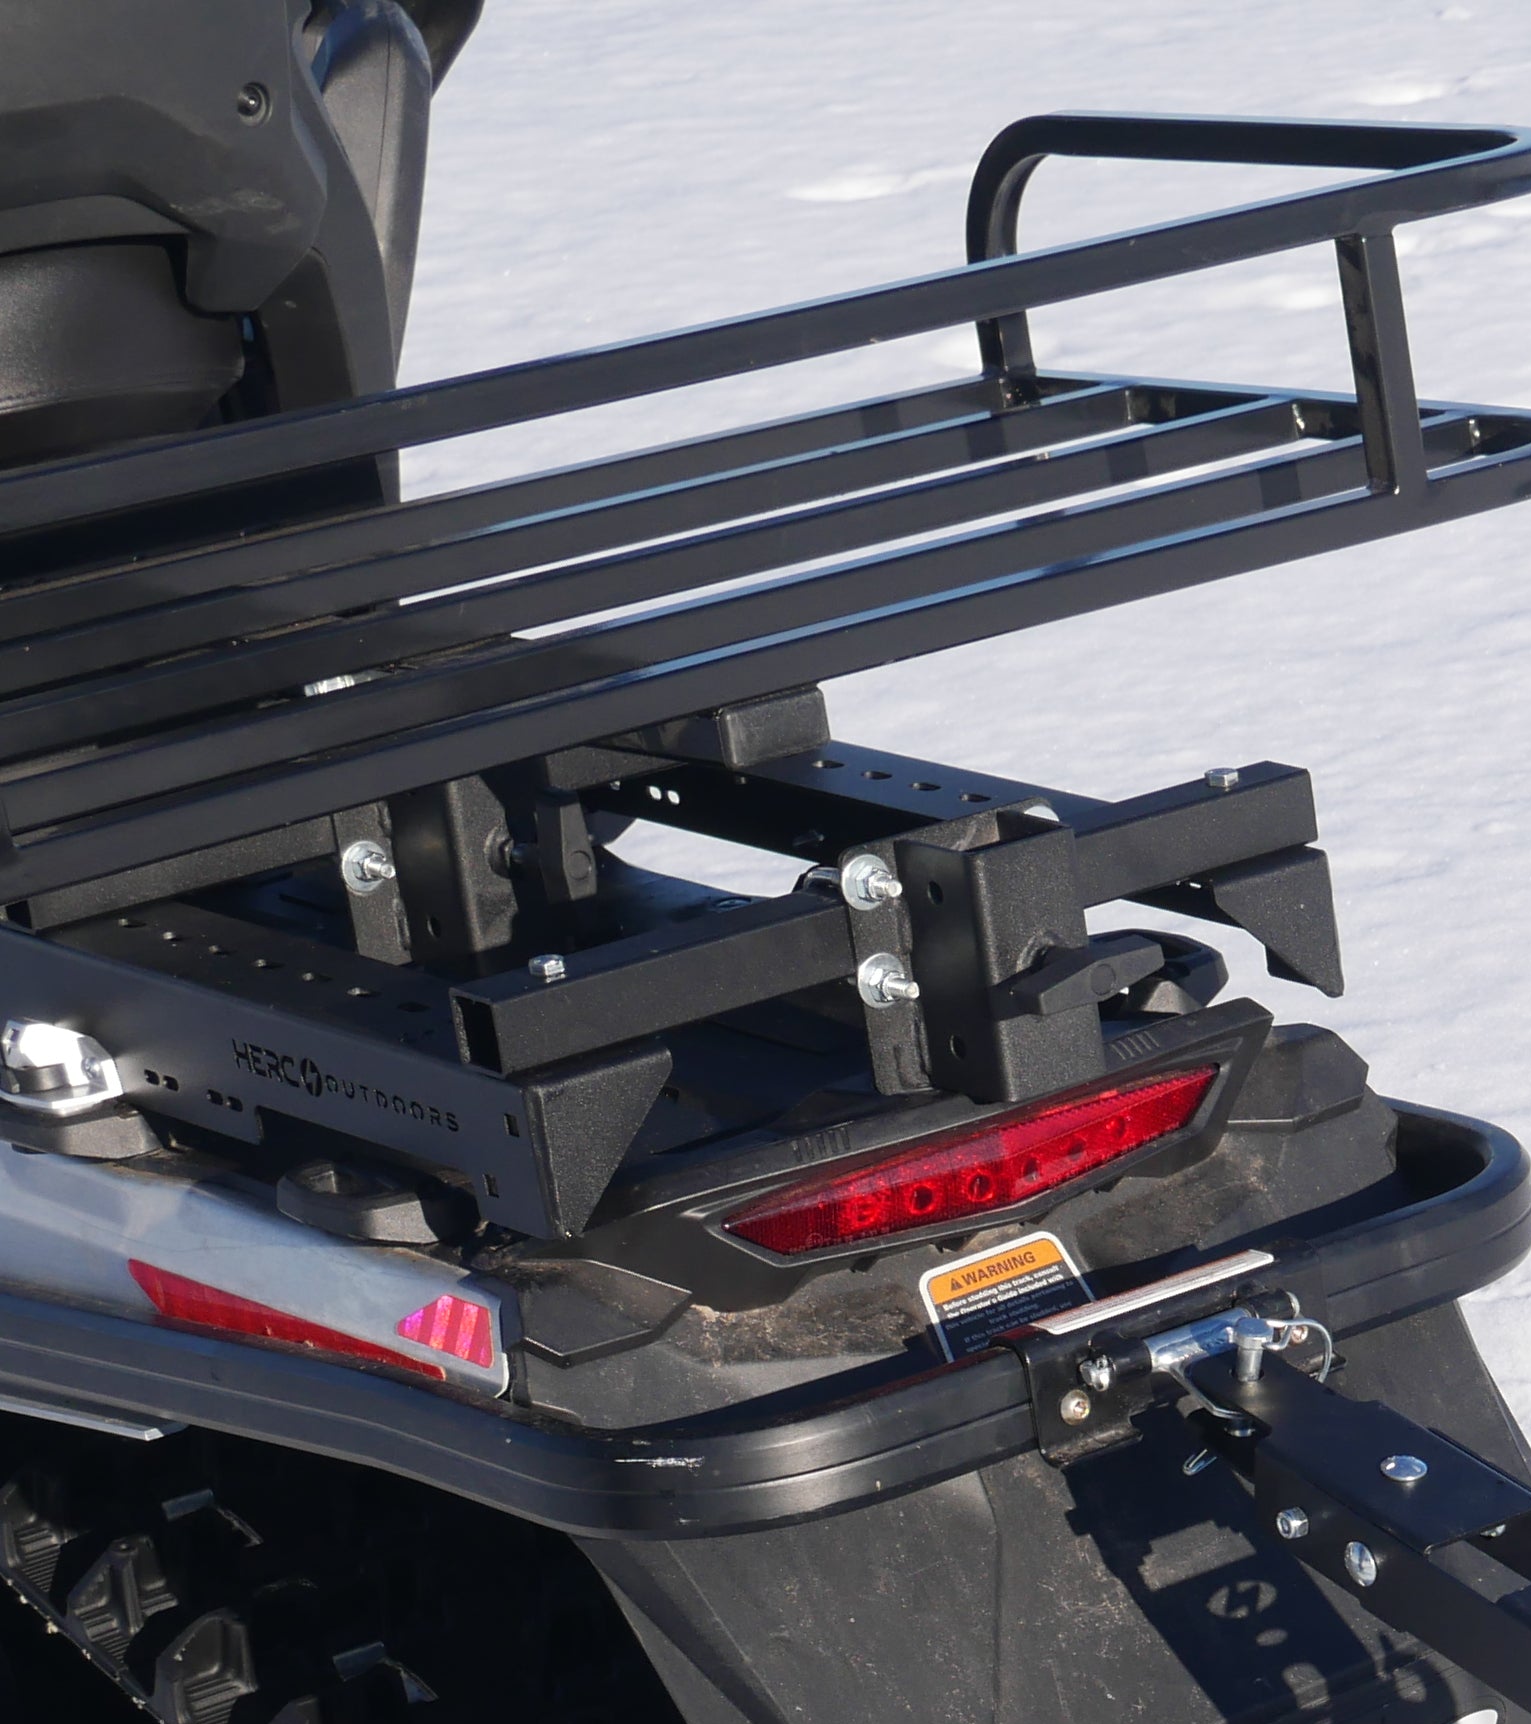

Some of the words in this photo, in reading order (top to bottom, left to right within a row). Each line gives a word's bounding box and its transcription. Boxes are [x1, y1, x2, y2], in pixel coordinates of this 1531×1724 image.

[325, 1074, 460, 1133] OUTDOORS
[961, 1251, 1036, 1286] WARNING
[942, 1299, 967, 1311] Before
[997, 1282, 1012, 1291] this
[1018, 1279, 1047, 1295] included
